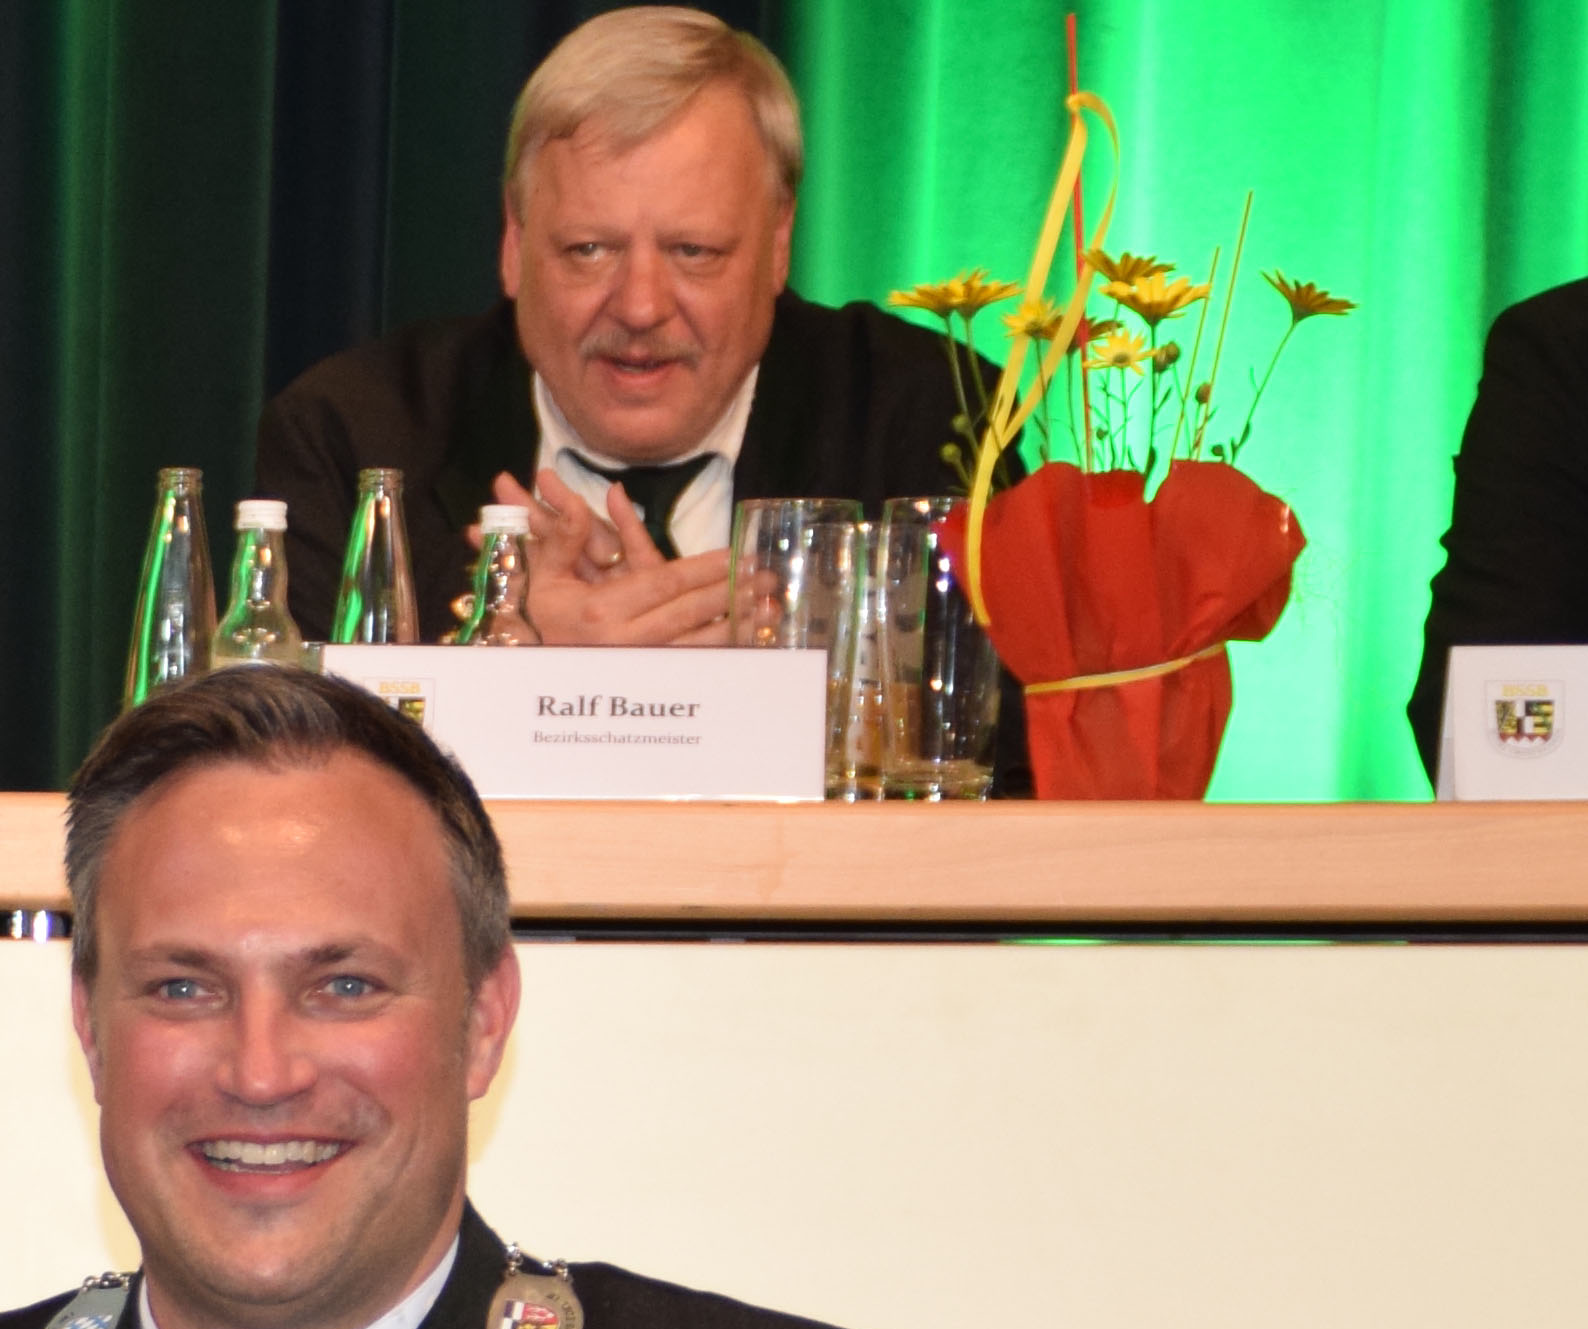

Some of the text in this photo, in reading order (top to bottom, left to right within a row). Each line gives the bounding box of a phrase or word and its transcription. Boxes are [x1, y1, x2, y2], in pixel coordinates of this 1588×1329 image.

[536, 695, 701, 717] Ralf Bauer
[533, 731, 703, 745] Bezirksschatzmeister
